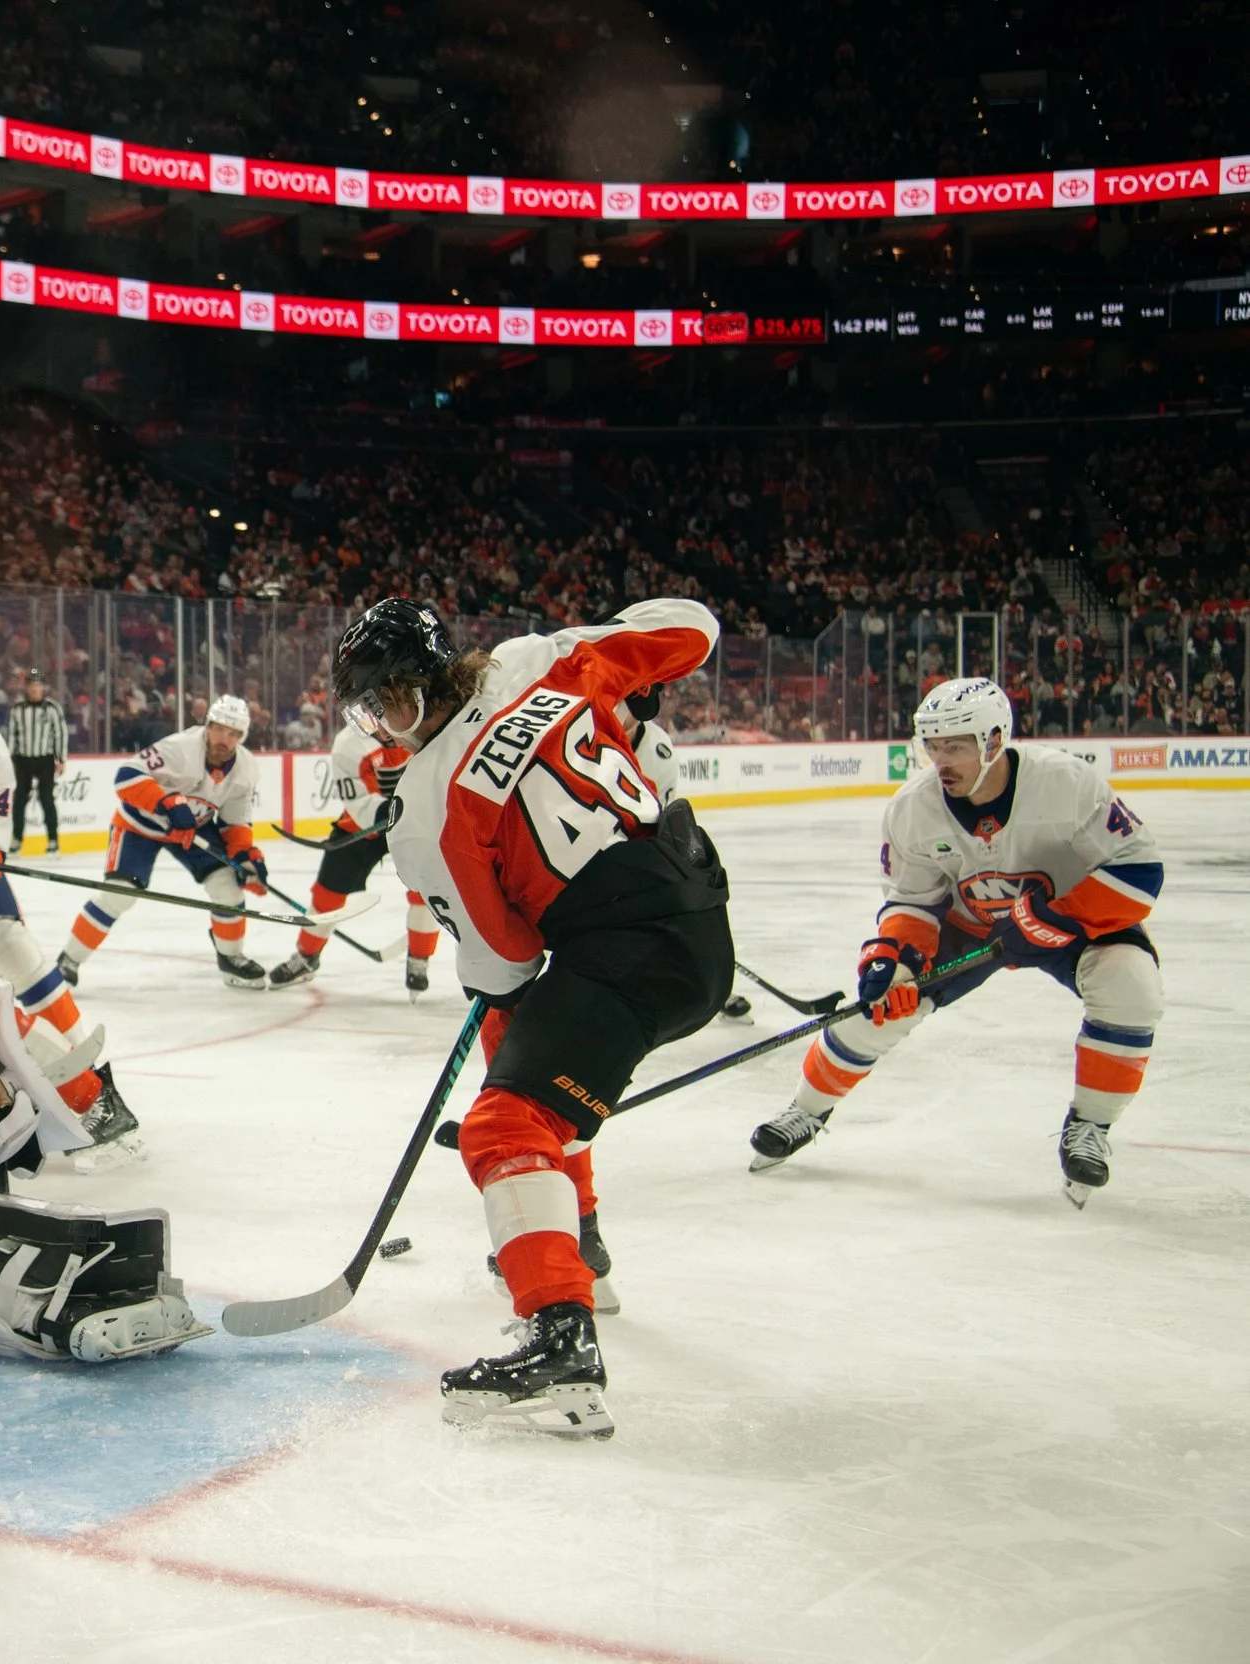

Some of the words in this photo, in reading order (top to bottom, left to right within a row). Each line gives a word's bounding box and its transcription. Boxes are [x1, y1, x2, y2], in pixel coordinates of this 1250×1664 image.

[11, 130, 86, 163] TOYOTA
[128, 153, 204, 182] TOYOTA
[252, 168, 330, 195] TOYOTA
[375, 181, 461, 204] TOYOTA
[1104, 170, 1208, 195] TOYOTA
[511, 188, 596, 210] TOYOTA
[647, 192, 738, 211] TOYOTA
[793, 191, 886, 211] TOYOTA
[945, 182, 1043, 205] TOYOTA
[41, 277, 113, 306] TOYOTA
[154, 293, 233, 319] TOYOTA
[281, 305, 357, 329] TOYOTA
[406, 313, 491, 334] TOYOTA
[542, 318, 626, 338] TOYOTA
[753, 318, 823, 337] $25,675
[865, 318, 888, 333] PM
[470, 695, 571, 790] ZEGRAS
[140, 745, 165, 771] 53
[810, 756, 862, 777] ticketmaster
[1118, 751, 1160, 766] MIKE'S
[688, 759, 710, 781] WIN!
[514, 703, 662, 884] 46
